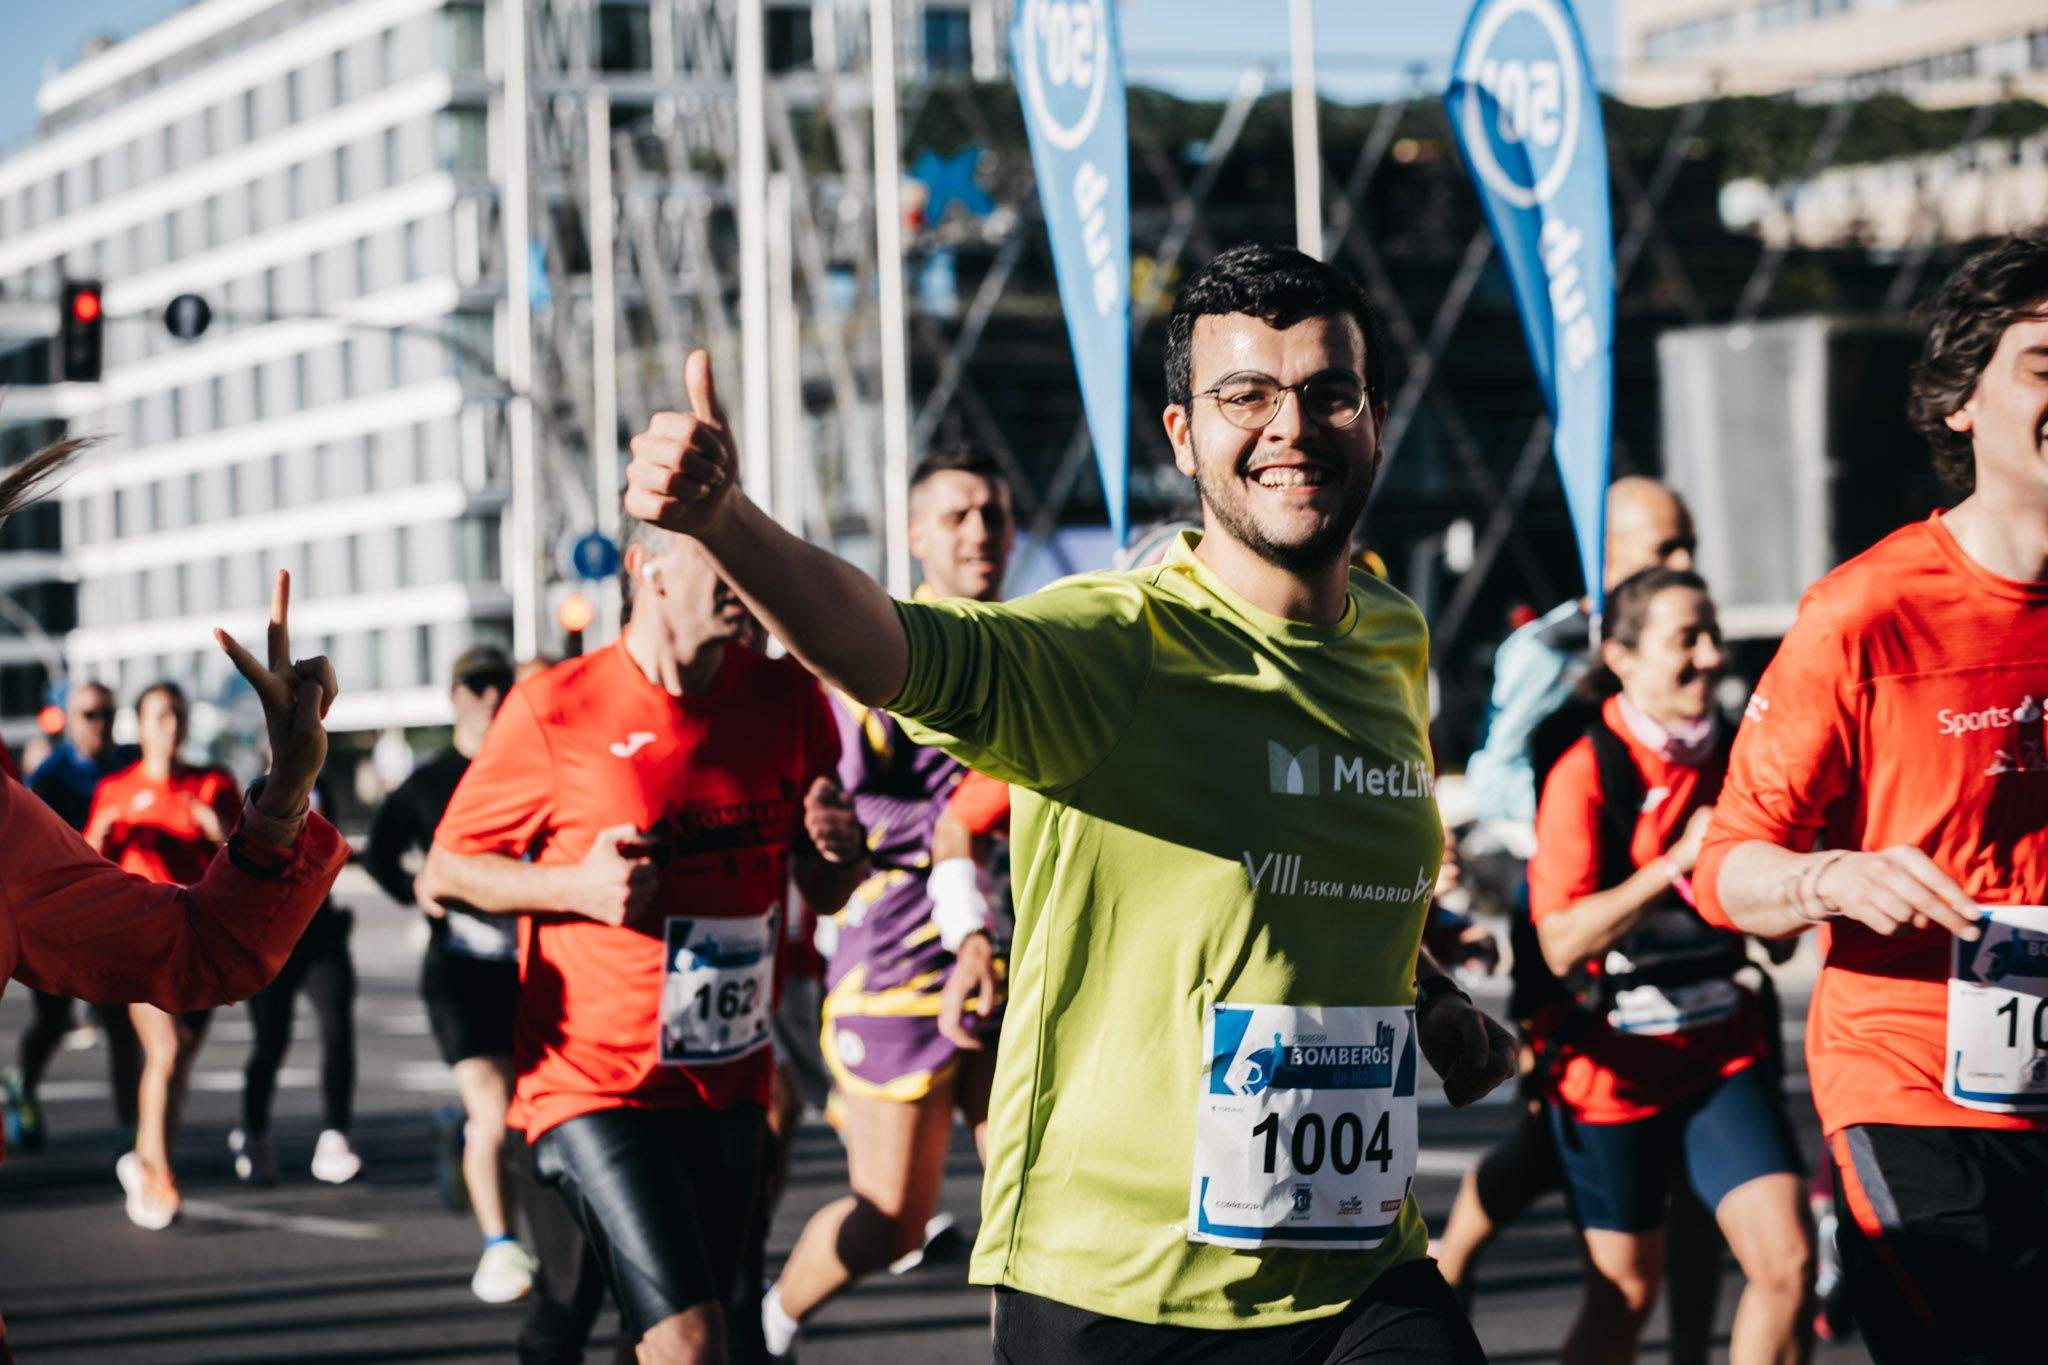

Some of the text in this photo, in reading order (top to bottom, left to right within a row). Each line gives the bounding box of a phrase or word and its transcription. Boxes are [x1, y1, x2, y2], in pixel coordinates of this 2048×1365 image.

[1936, 706, 2012, 739] Sports
[1243, 850, 1302, 896] VIII
[1303, 879, 1344, 899] 15KM
[1349, 883, 1411, 903] MADRID
[1289, 1046, 1390, 1067] BOMBEROS
[1252, 1110, 1393, 1176] 1004
